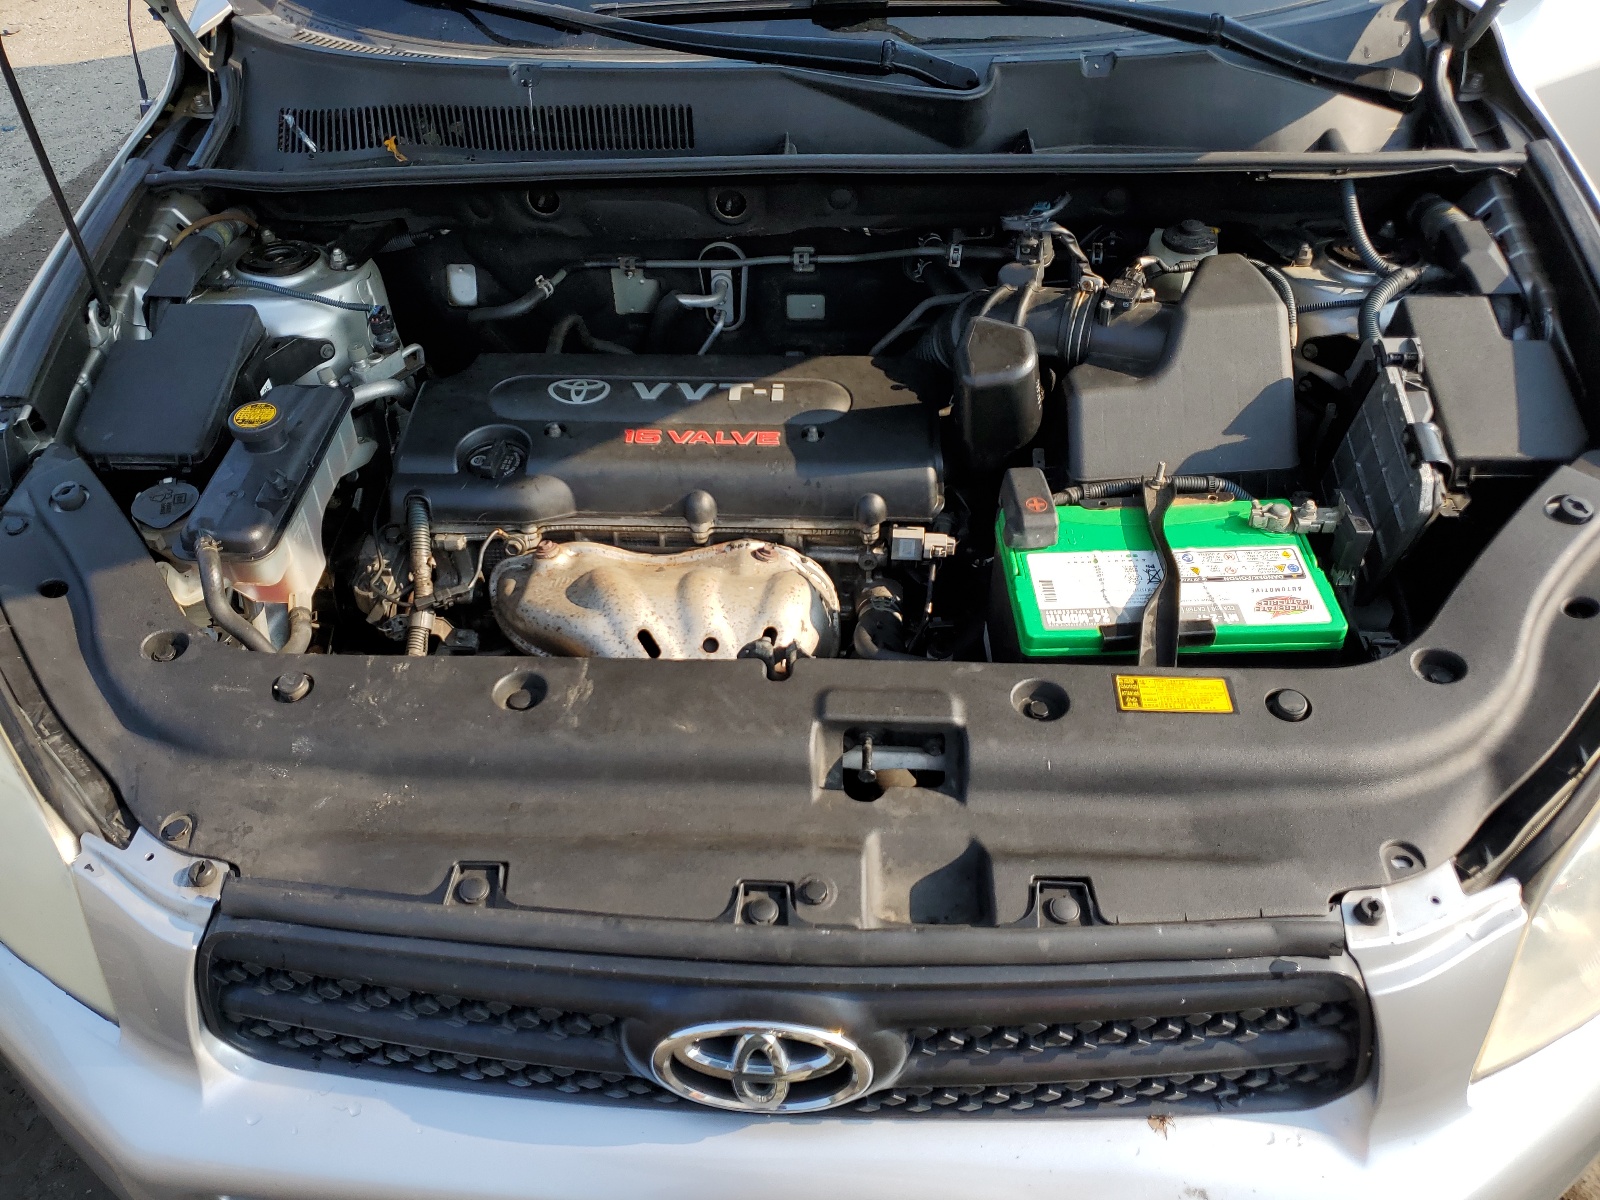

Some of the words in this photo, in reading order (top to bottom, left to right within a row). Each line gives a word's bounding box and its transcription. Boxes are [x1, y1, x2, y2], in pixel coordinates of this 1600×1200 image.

[632, 382, 785, 401] VVT-i
[625, 429, 662, 444] 16
[668, 430, 781, 446] VALVE
[1251, 586, 1302, 594] AUTOMOTIVE
[1046, 614, 1111, 623] 24-MONTH
